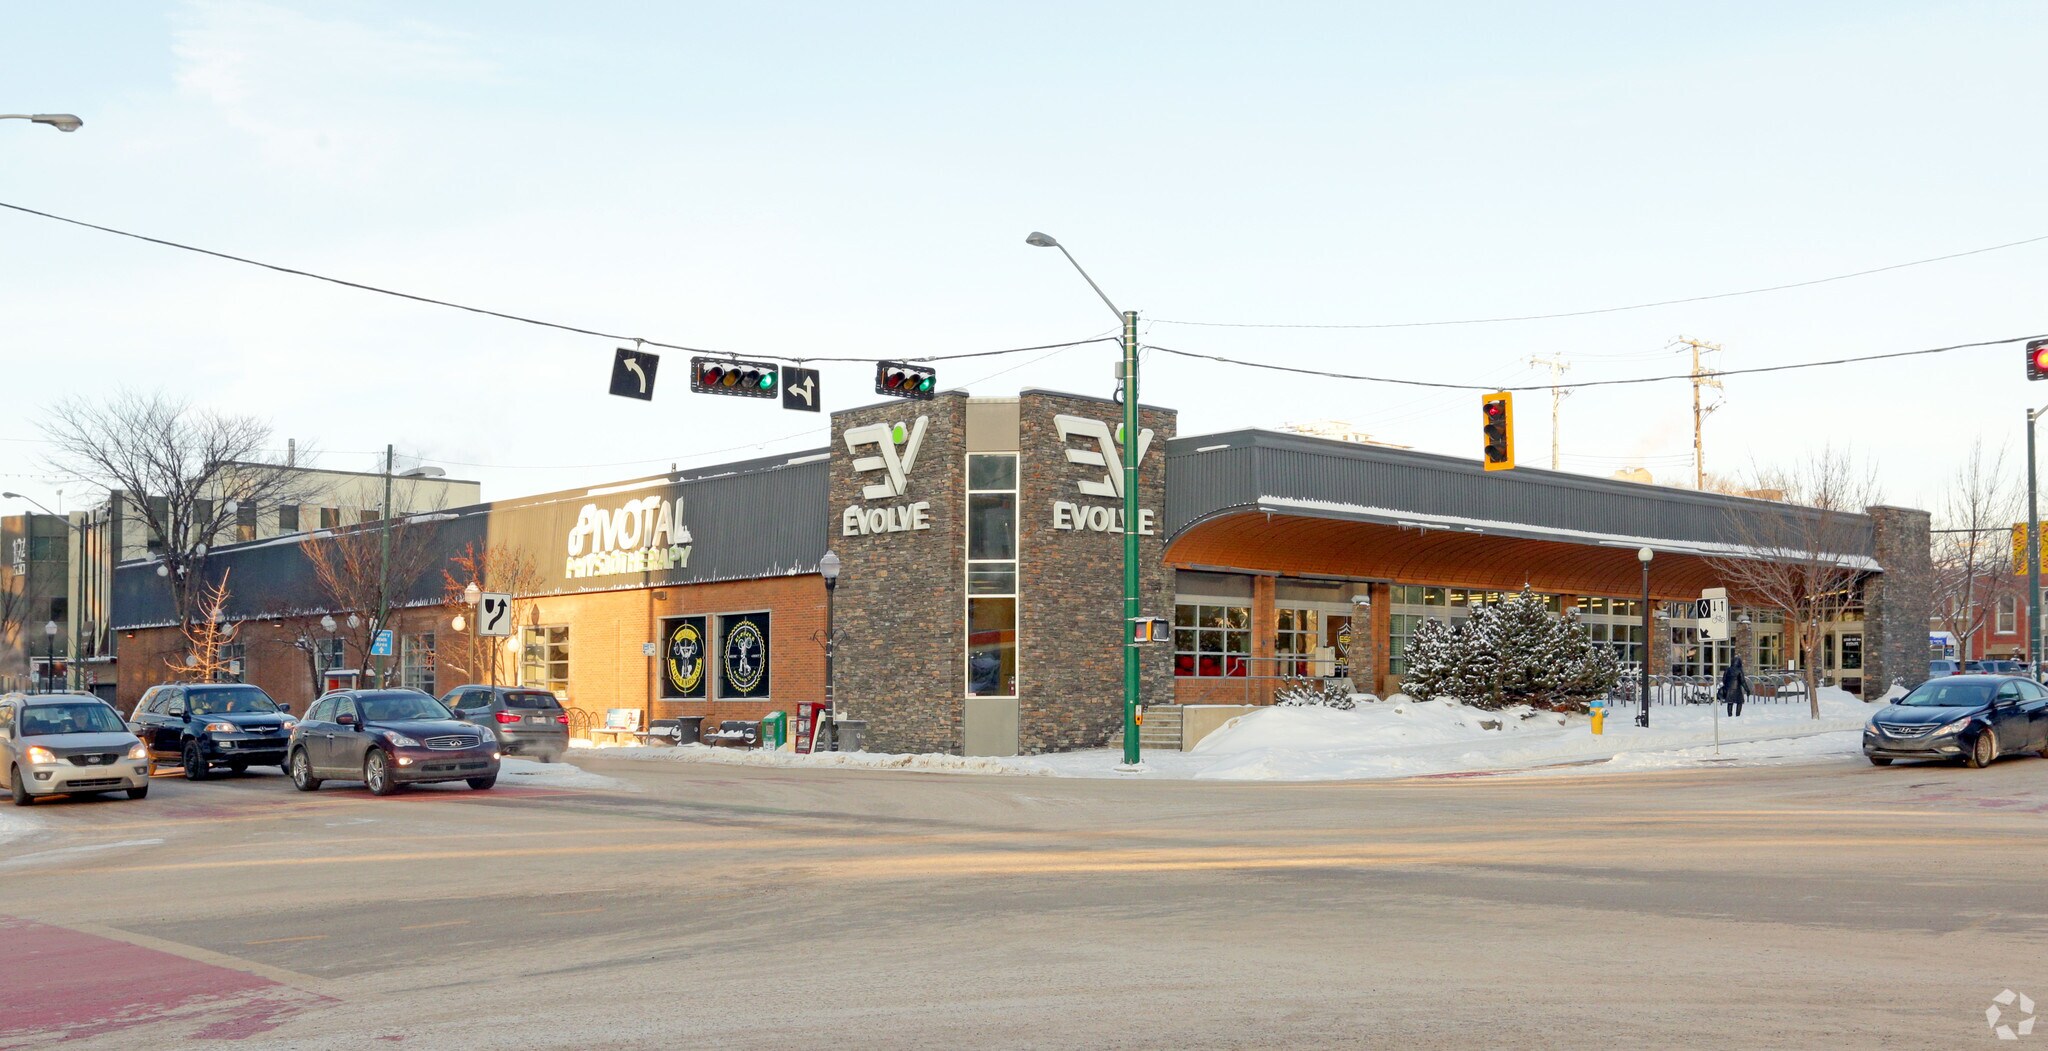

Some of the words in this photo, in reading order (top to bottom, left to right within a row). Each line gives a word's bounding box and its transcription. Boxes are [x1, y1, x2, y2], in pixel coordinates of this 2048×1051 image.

[568, 496, 692, 556] PIVOTAL
[843, 501, 930, 536] EVOLVE
[1053, 501, 1154, 535] EVOLE
[565, 545, 692, 578] PHYSIOTHERAPY
